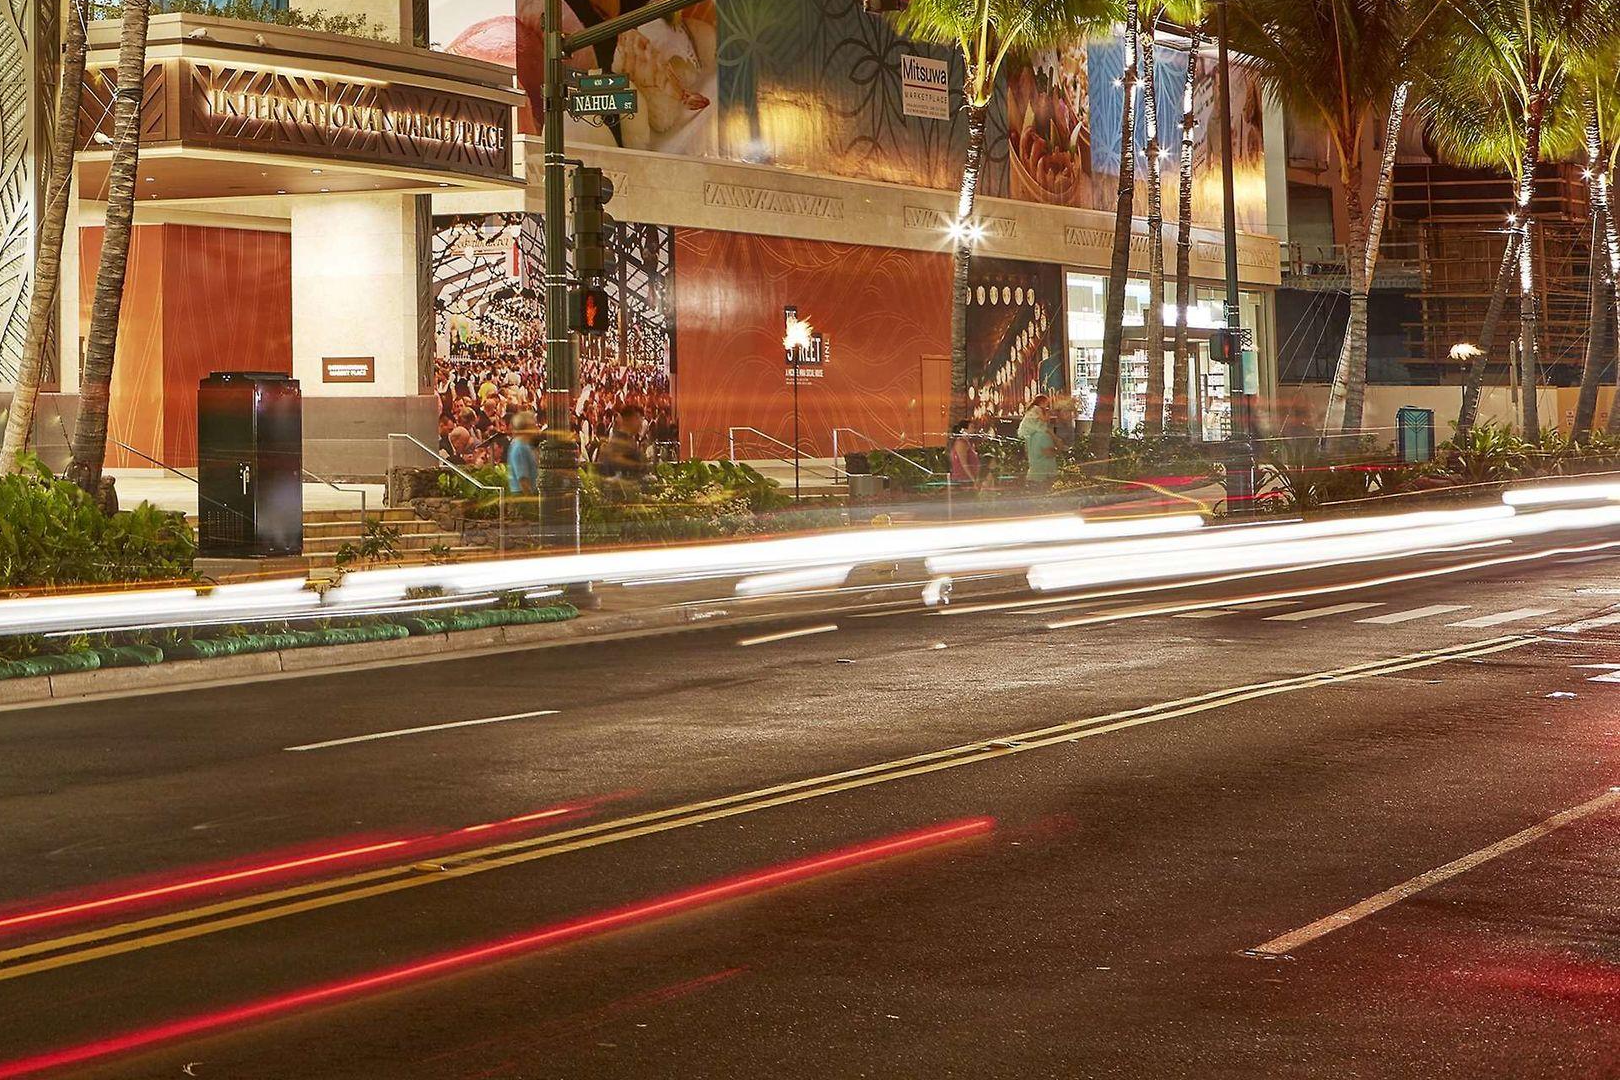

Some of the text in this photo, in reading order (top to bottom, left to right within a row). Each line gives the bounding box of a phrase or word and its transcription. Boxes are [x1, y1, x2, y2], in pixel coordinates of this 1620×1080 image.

[903, 58, 947, 85] Mitsuwa
[212, 89, 383, 133] INTERNATIONAL
[575, 95, 617, 111] NAHUA
[905, 91, 948, 105] MARKETPLACE
[786, 336, 821, 362] SREET
